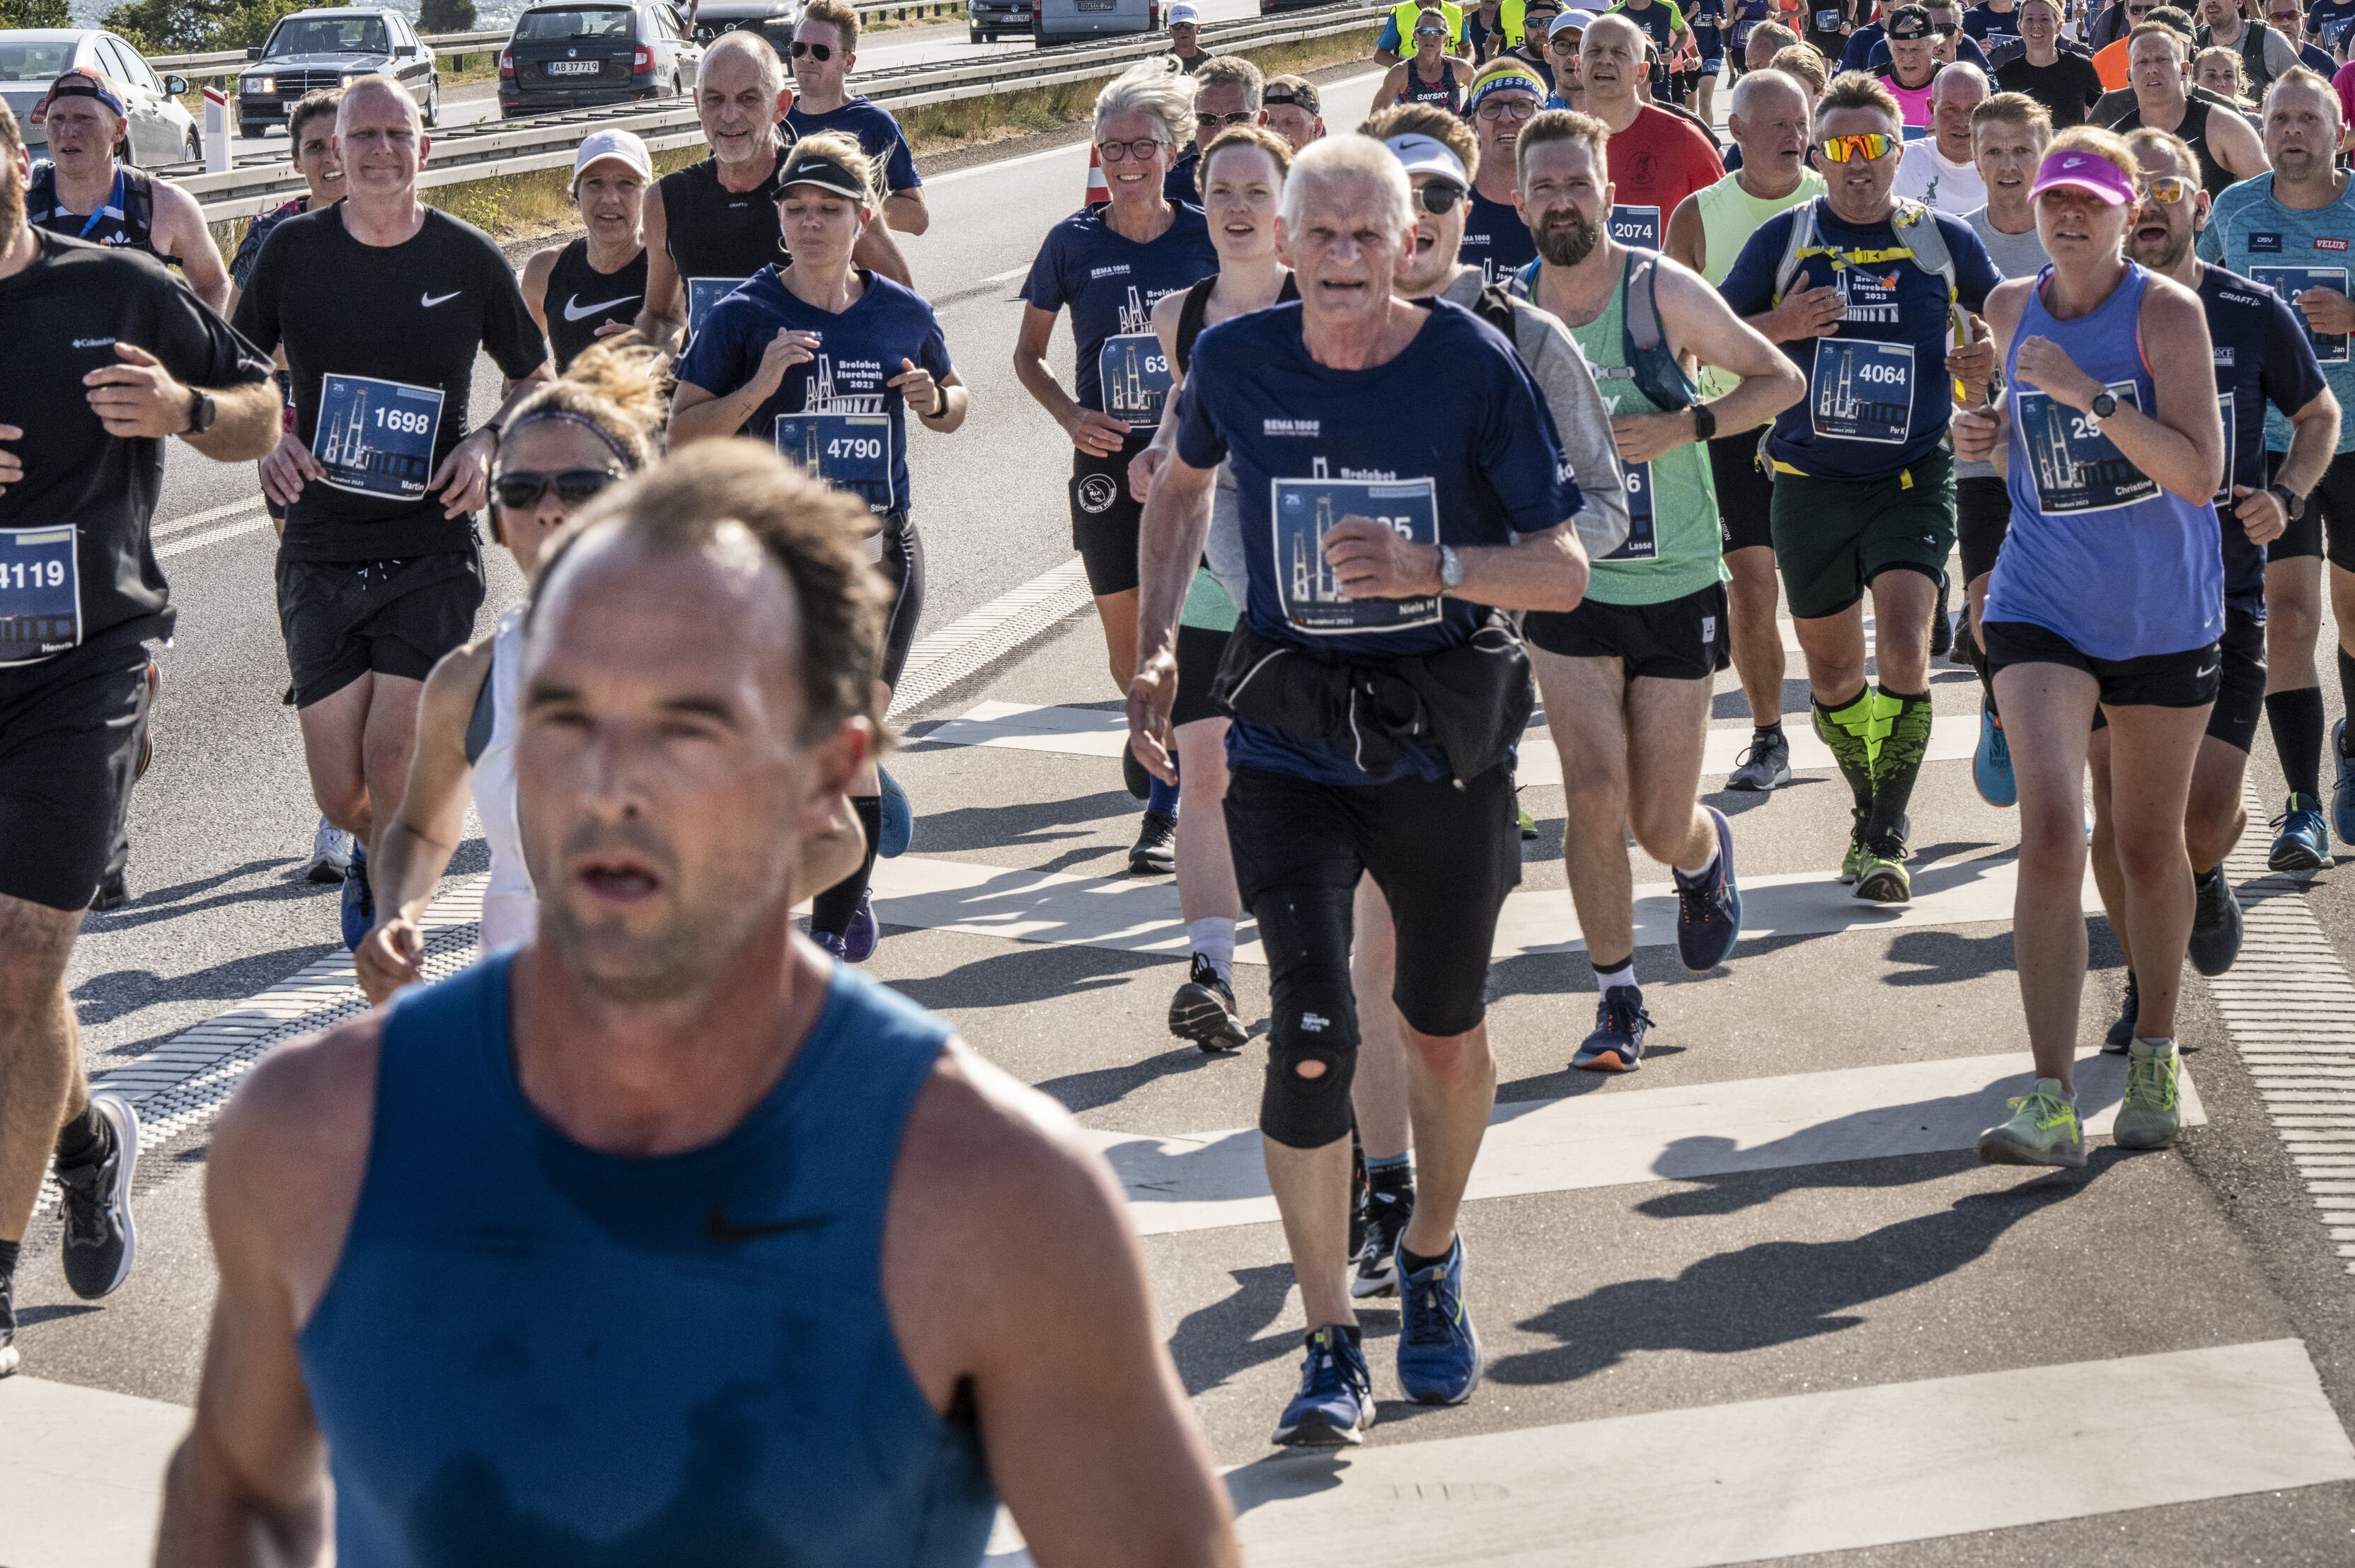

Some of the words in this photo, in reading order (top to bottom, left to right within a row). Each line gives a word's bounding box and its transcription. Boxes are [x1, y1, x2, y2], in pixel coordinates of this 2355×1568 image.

[555, 63, 566, 71] AB
[568, 63, 580, 71] 37
[581, 62, 597, 71] 719
[1417, 91, 1449, 101] SAYSKY
[1615, 223, 1653, 238] 2074
[2316, 240, 2347, 249] VELUX
[1090, 266, 1112, 277] REMA
[2219, 292, 2253, 304] CRAFT
[2214, 349, 2233, 359] RCE
[1145, 354, 1169, 373] 63
[1859, 364, 1906, 385] 4064
[375, 407, 430, 435] 1698
[784, 424, 795, 432] 25
[2071, 417, 2101, 439] 29
[827, 439, 881, 459] 4790
[401, 480, 425, 491] Martin
[2115, 480, 2153, 495] Christine
[870, 503, 889, 513] Stine
[1720, 517, 1732, 541] FUSION
[1629, 541, 1653, 550] Lasse
[0, 560, 65, 589] 4119
[1399, 603, 1425, 615] Niels
[1426, 600, 1435, 610] H
[41, 641, 74, 652] Henrik
